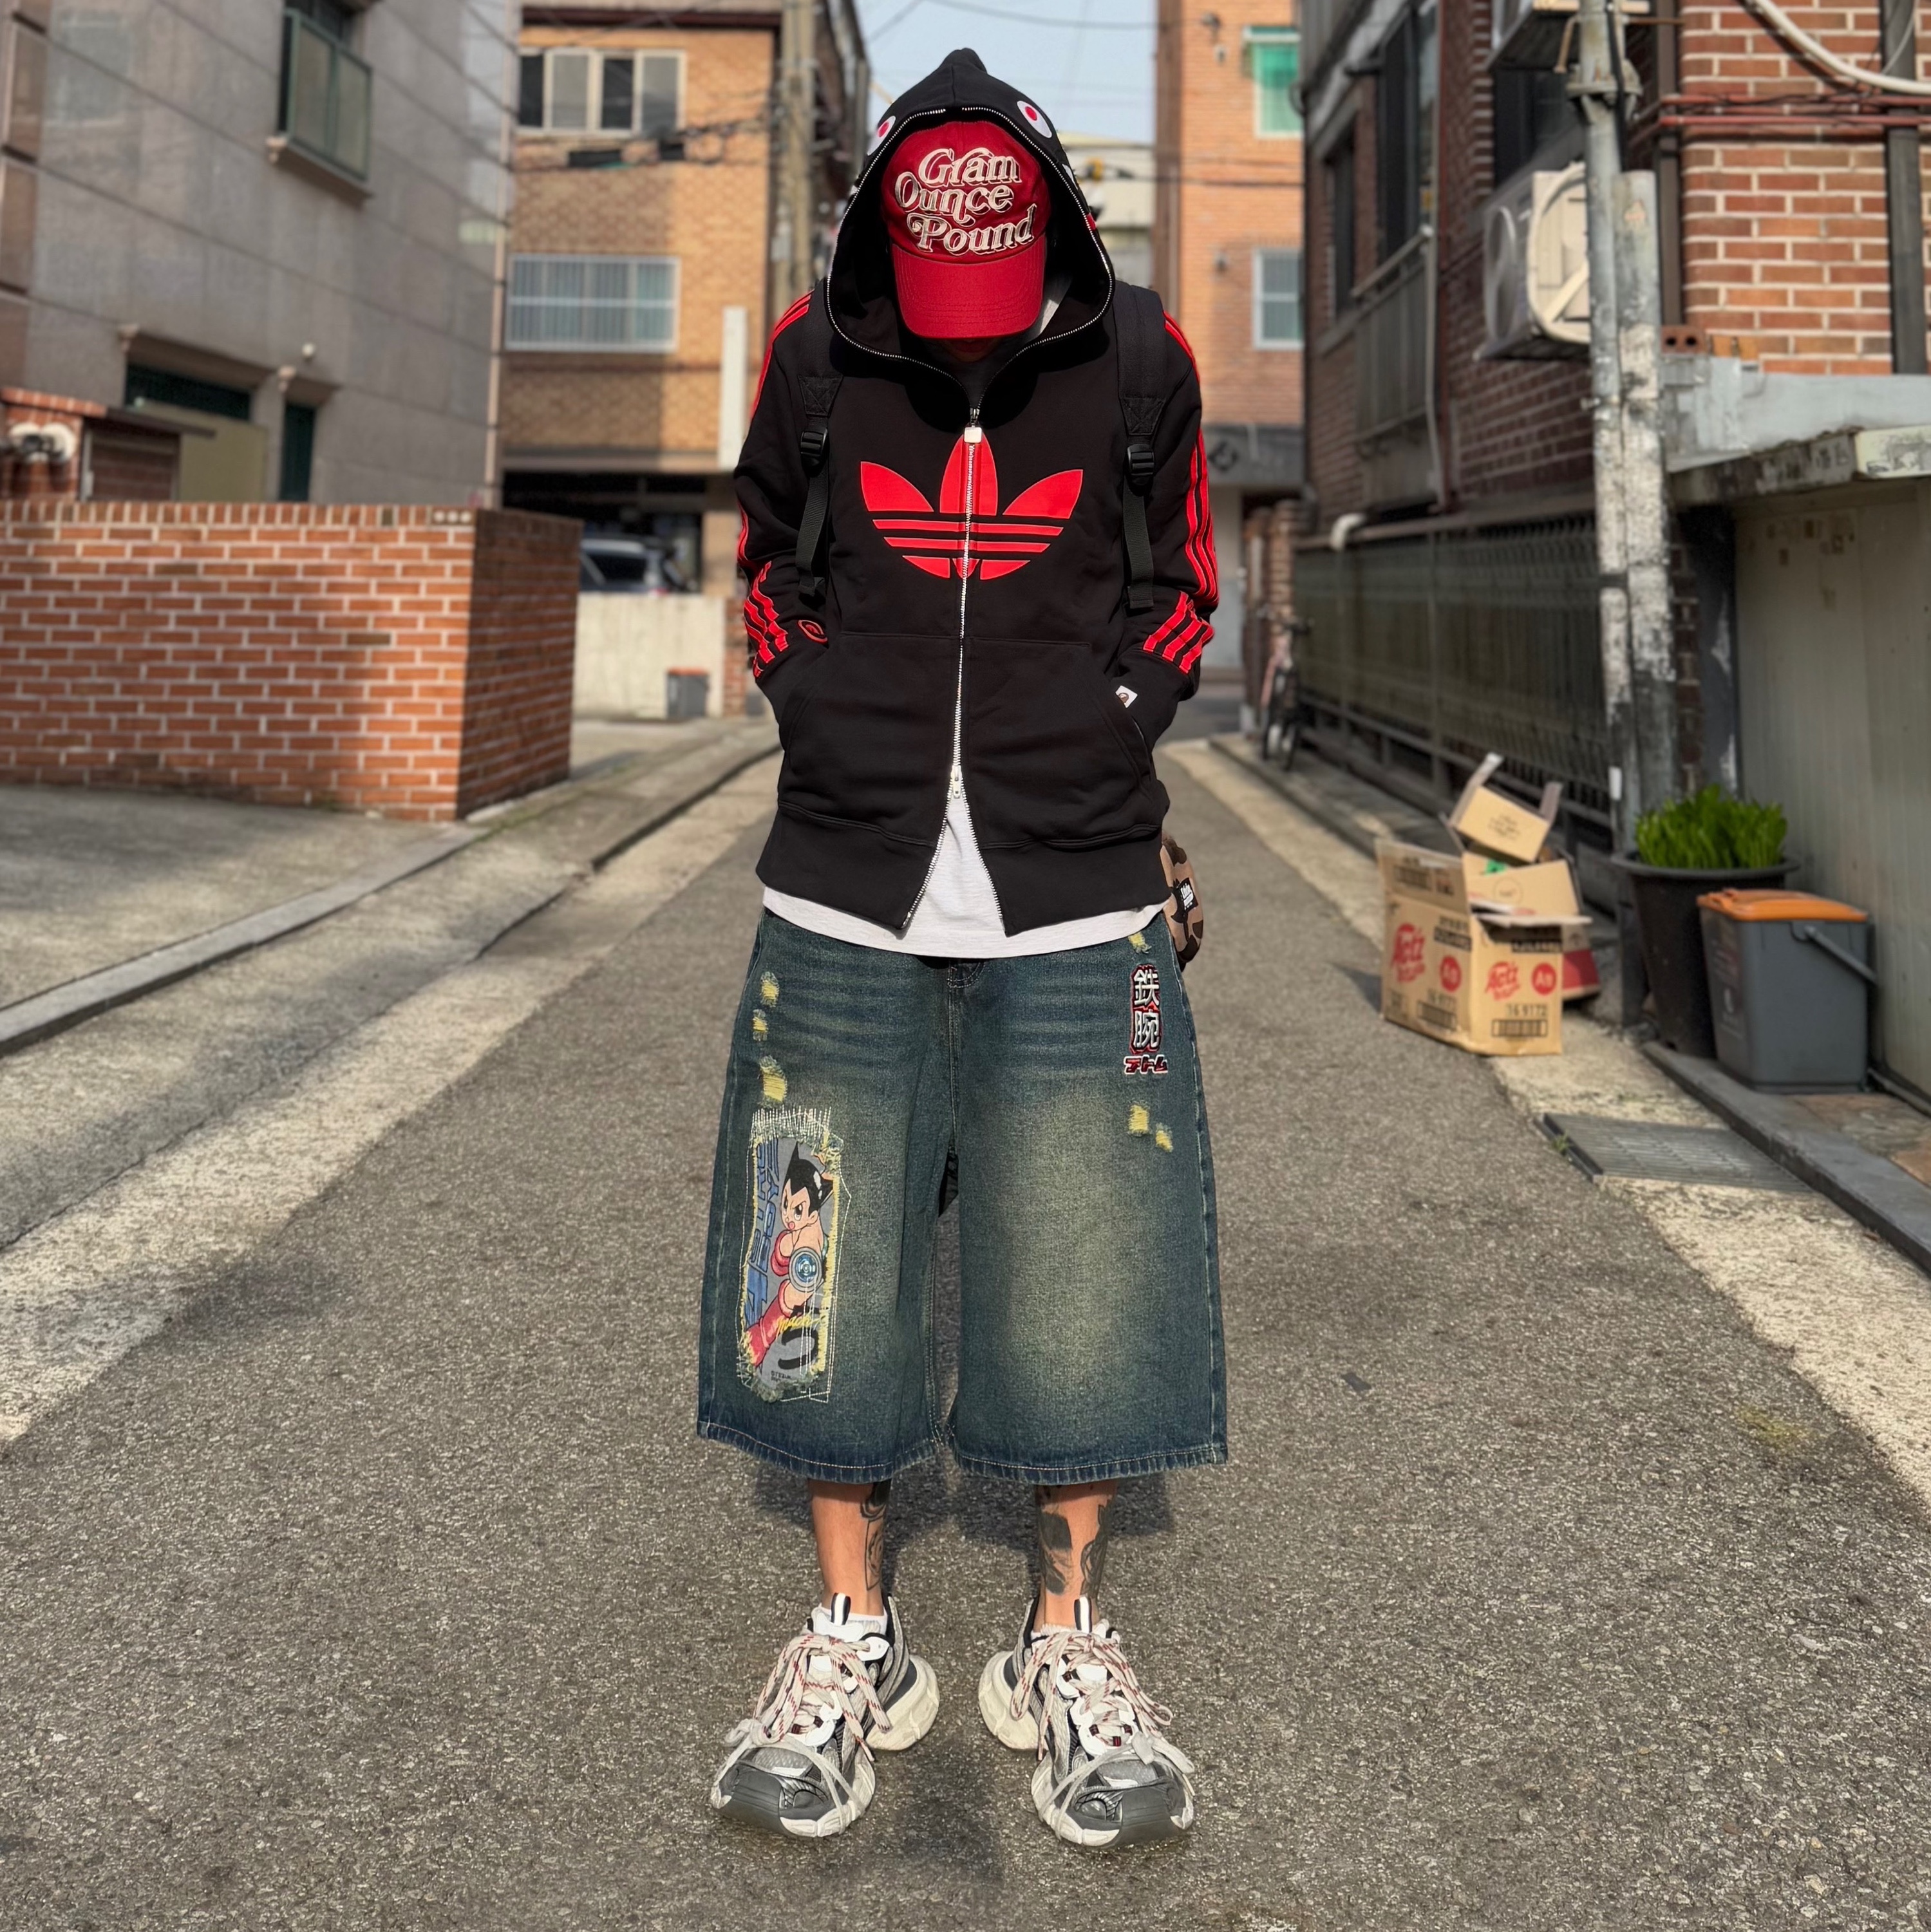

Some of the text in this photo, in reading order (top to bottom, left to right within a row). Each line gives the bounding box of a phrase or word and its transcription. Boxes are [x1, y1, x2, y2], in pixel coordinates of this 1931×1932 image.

[919, 147, 1022, 187] Gram
[895, 171, 1014, 227] Ounce
[907, 203, 1037, 256] Pound
[1133, 969, 1160, 1048] 鉄腕
[1124, 1054, 1169, 1074] アトム
